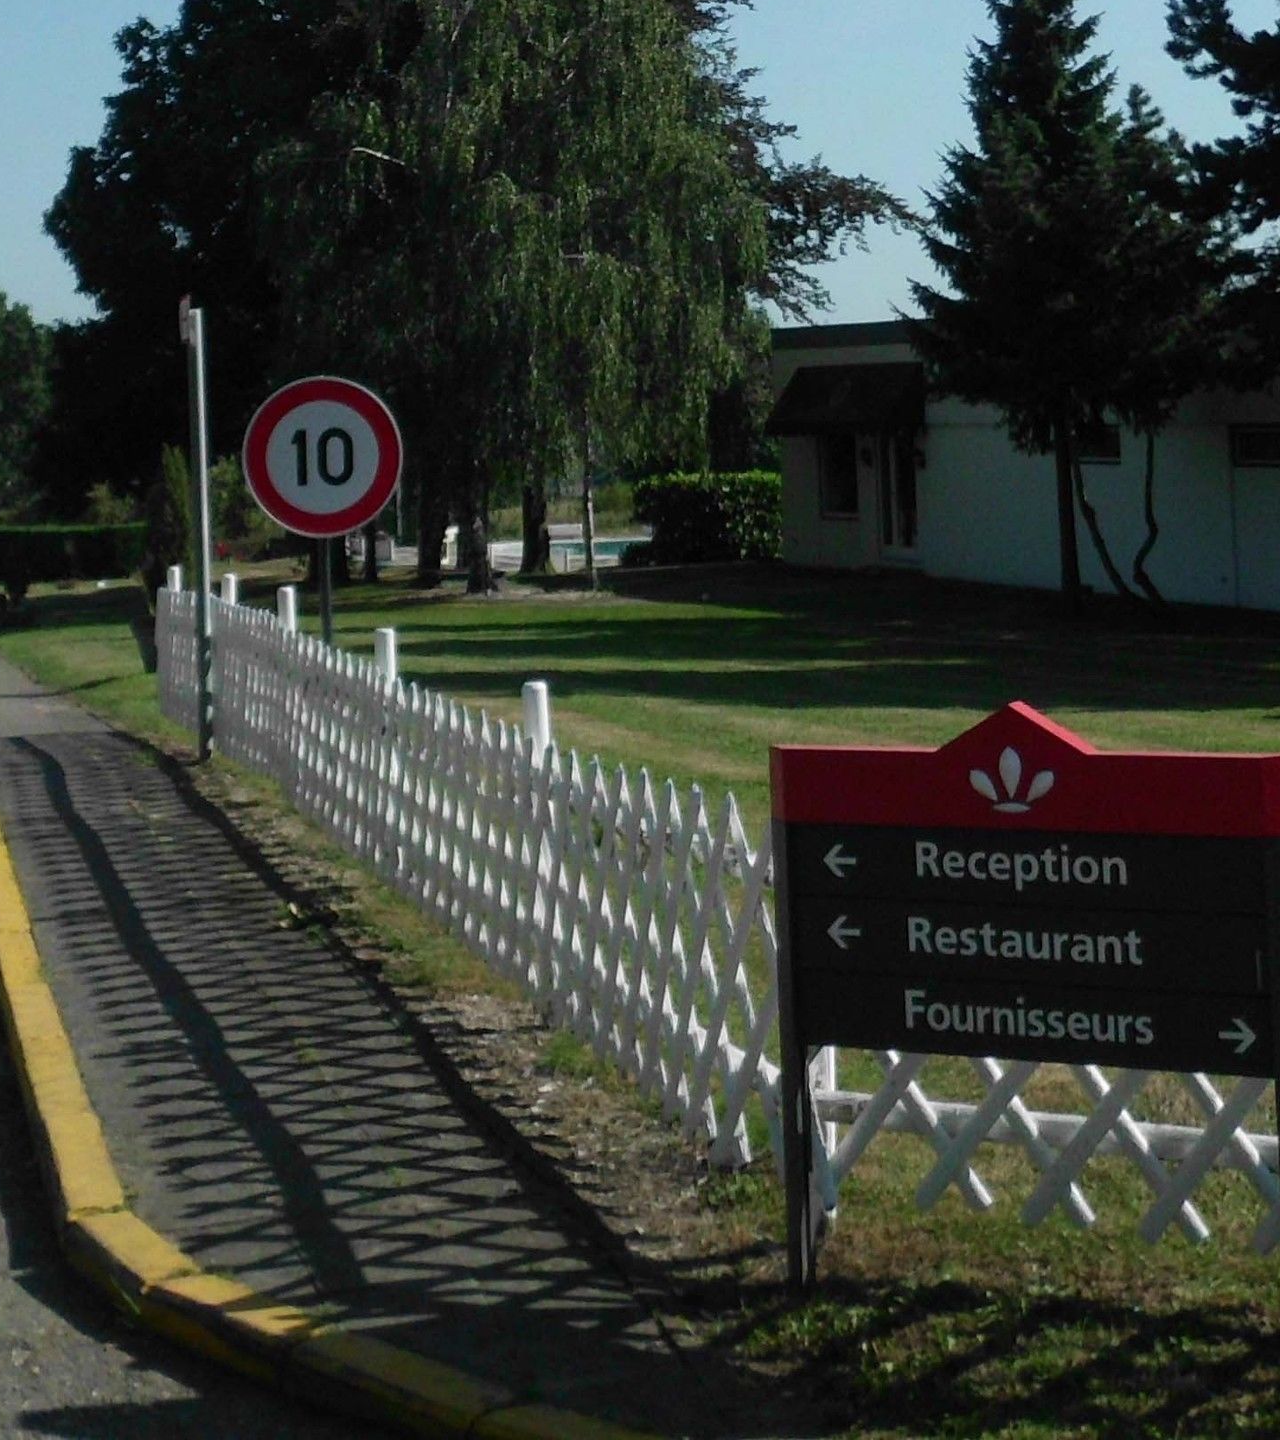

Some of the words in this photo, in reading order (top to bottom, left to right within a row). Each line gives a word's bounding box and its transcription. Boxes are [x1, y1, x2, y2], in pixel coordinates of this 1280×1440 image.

[291, 427, 354, 487] 10
[914, 840, 1129, 892] Reception
[906, 915, 1143, 967] Restaurant
[903, 988, 1155, 1046] Fournisseurs
